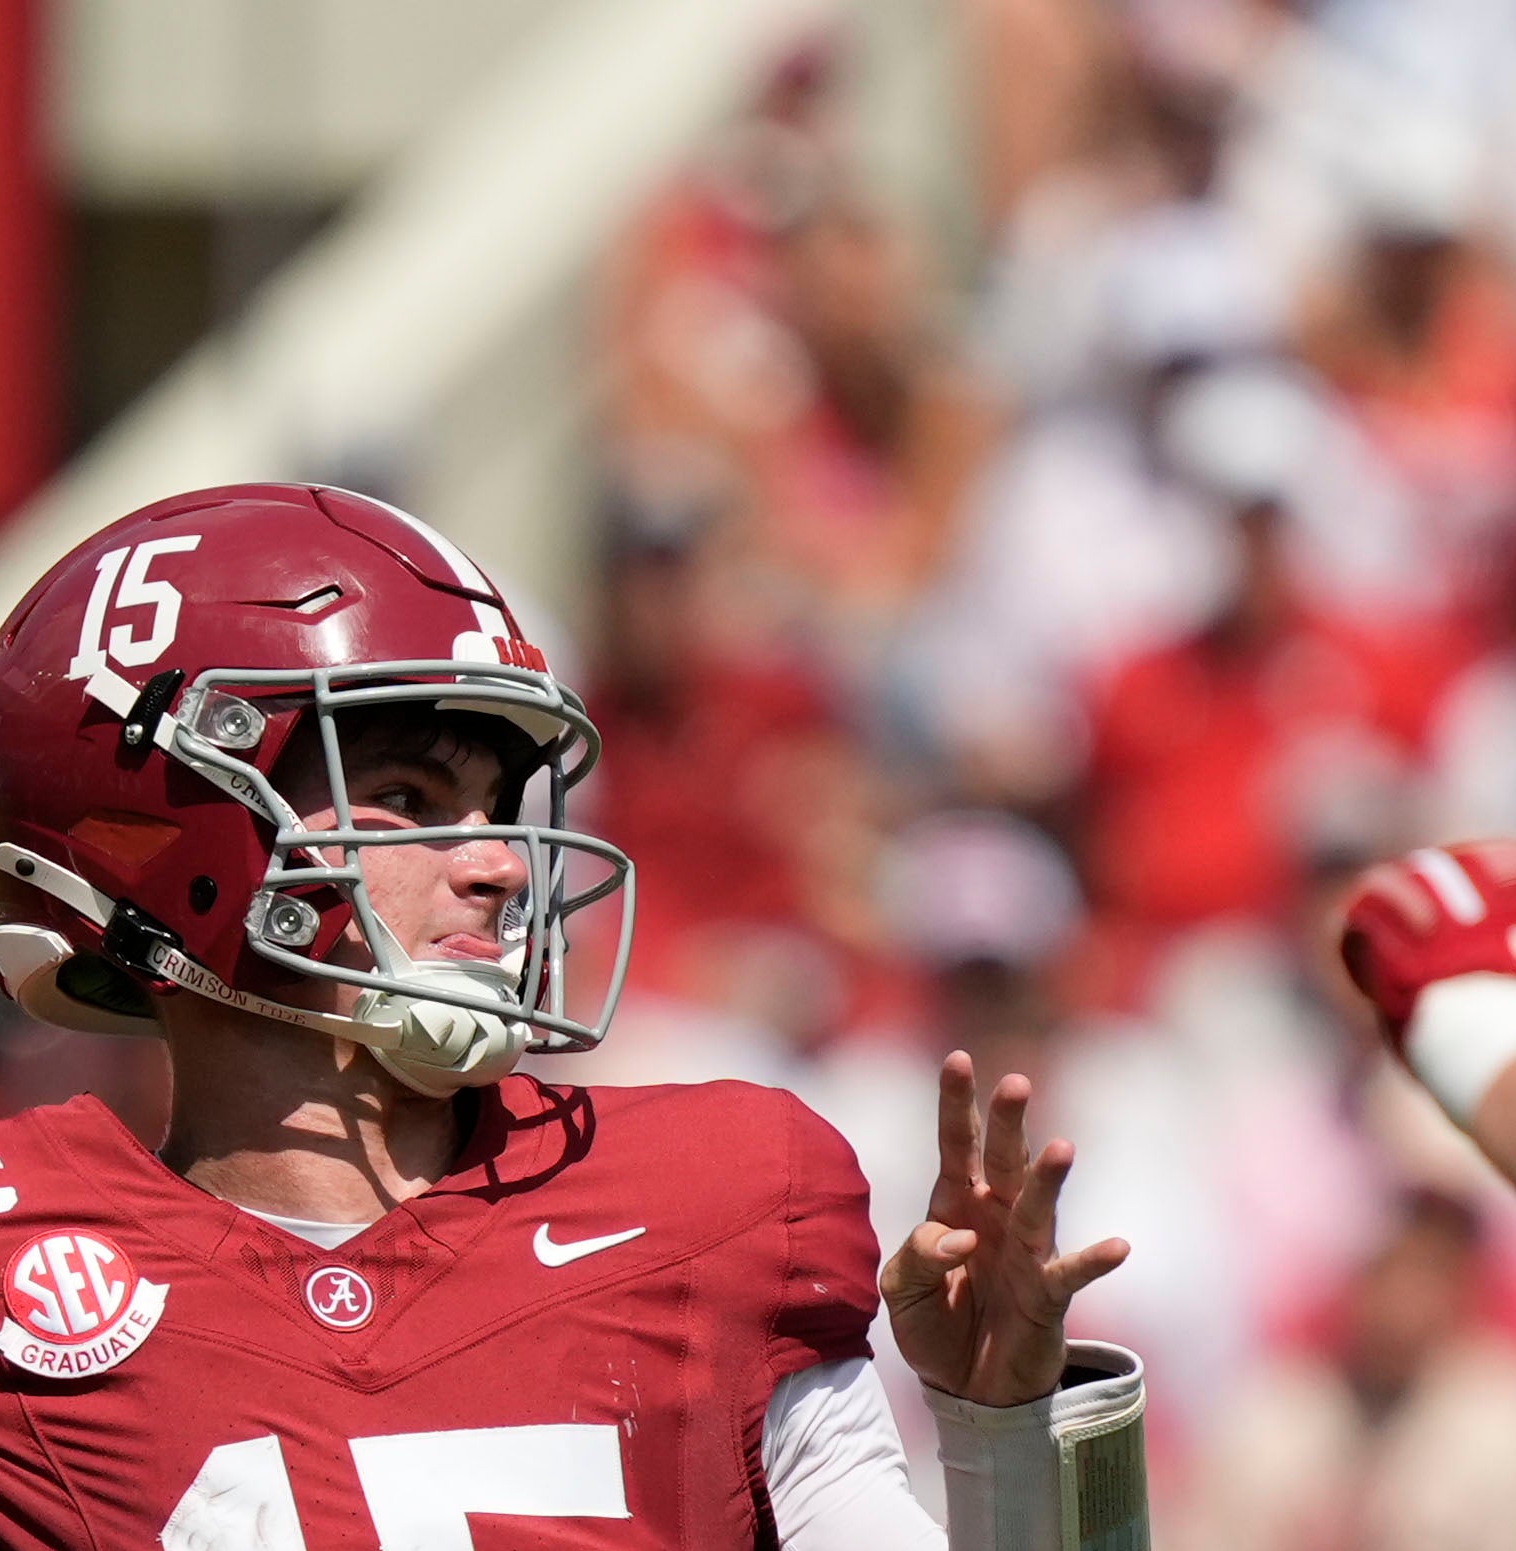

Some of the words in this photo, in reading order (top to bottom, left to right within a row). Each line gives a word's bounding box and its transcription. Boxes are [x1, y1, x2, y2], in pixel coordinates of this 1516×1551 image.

[69, 535, 202, 681] 15
[152, 945, 248, 1007] CRIMSON
[256, 1002, 306, 1025] TIDE
[14, 1235, 125, 1336] SEC
[318, 1276, 360, 1314] A
[21, 1310, 152, 1374] GRADUATE
